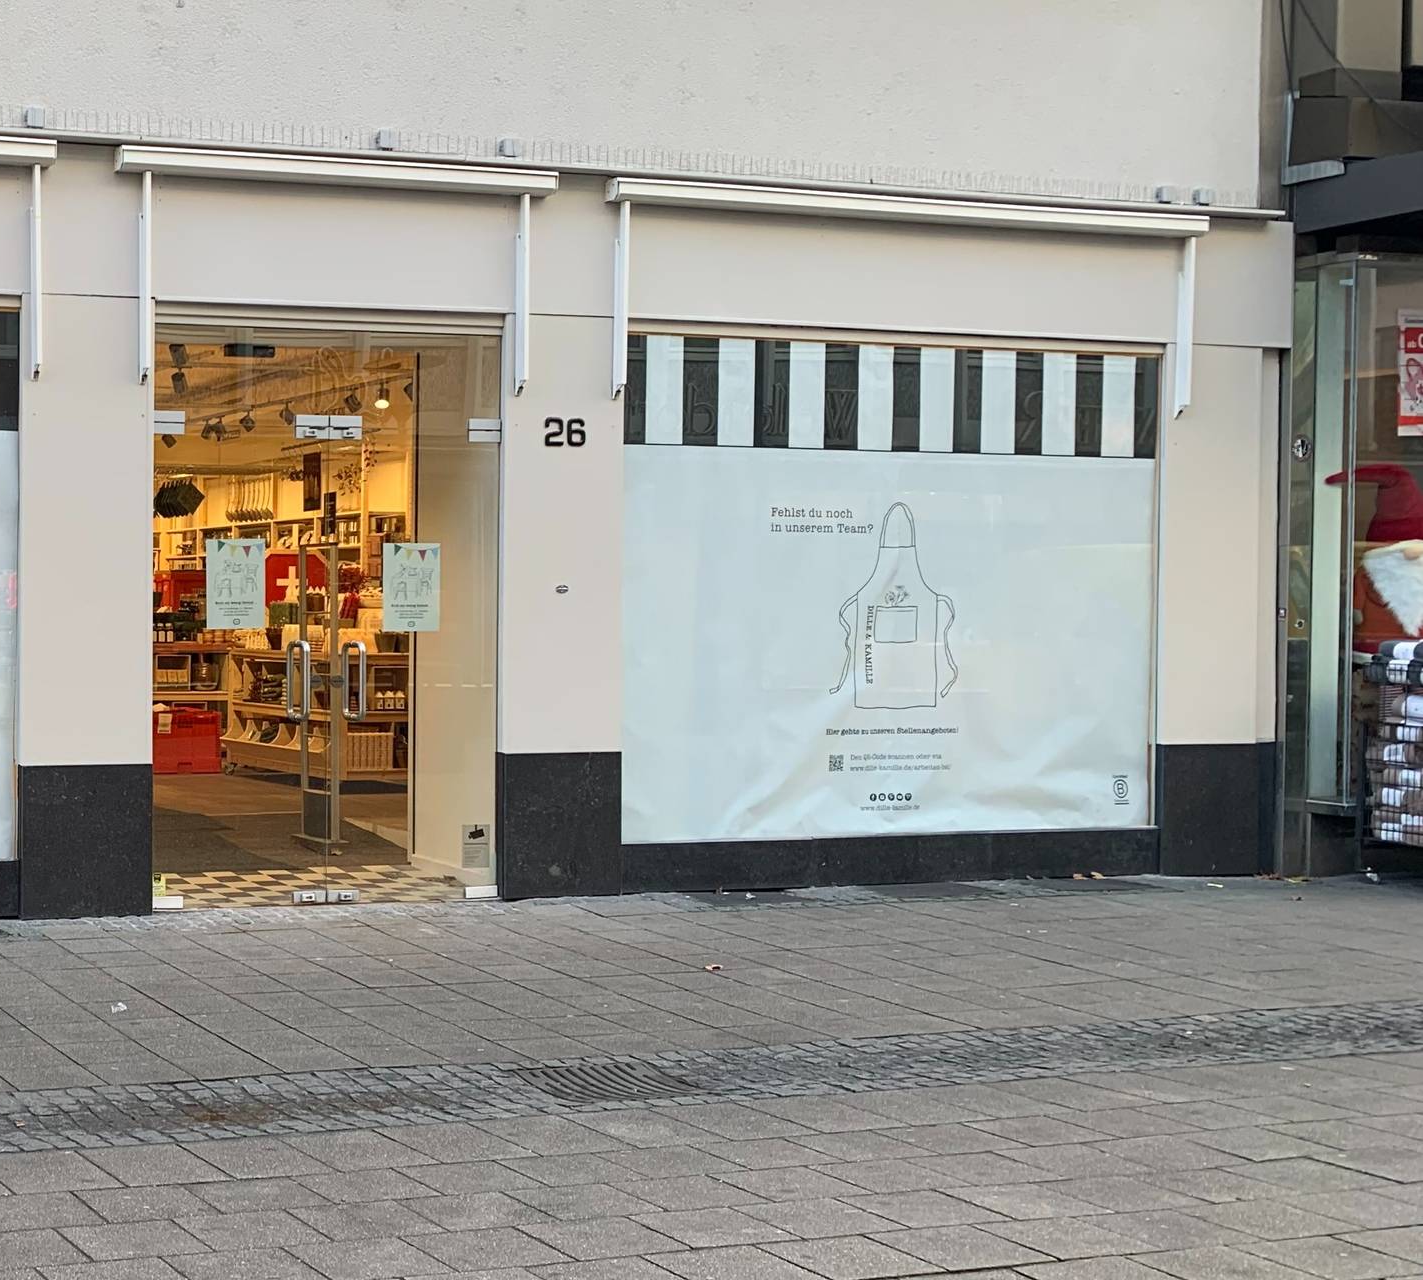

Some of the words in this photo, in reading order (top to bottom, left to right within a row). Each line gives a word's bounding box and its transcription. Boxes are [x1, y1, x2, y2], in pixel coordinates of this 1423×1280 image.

[544, 416, 586, 447] 26
[771, 507, 806, 518] Fehlst
[808, 508, 822, 518] du
[826, 508, 853, 519] noch
[770, 522, 782, 533] in
[785, 524, 834, 533] unserem
[837, 524, 874, 534] Team?
[866, 605, 875, 631] DILLE
[864, 643, 874, 685] KAMILLE
